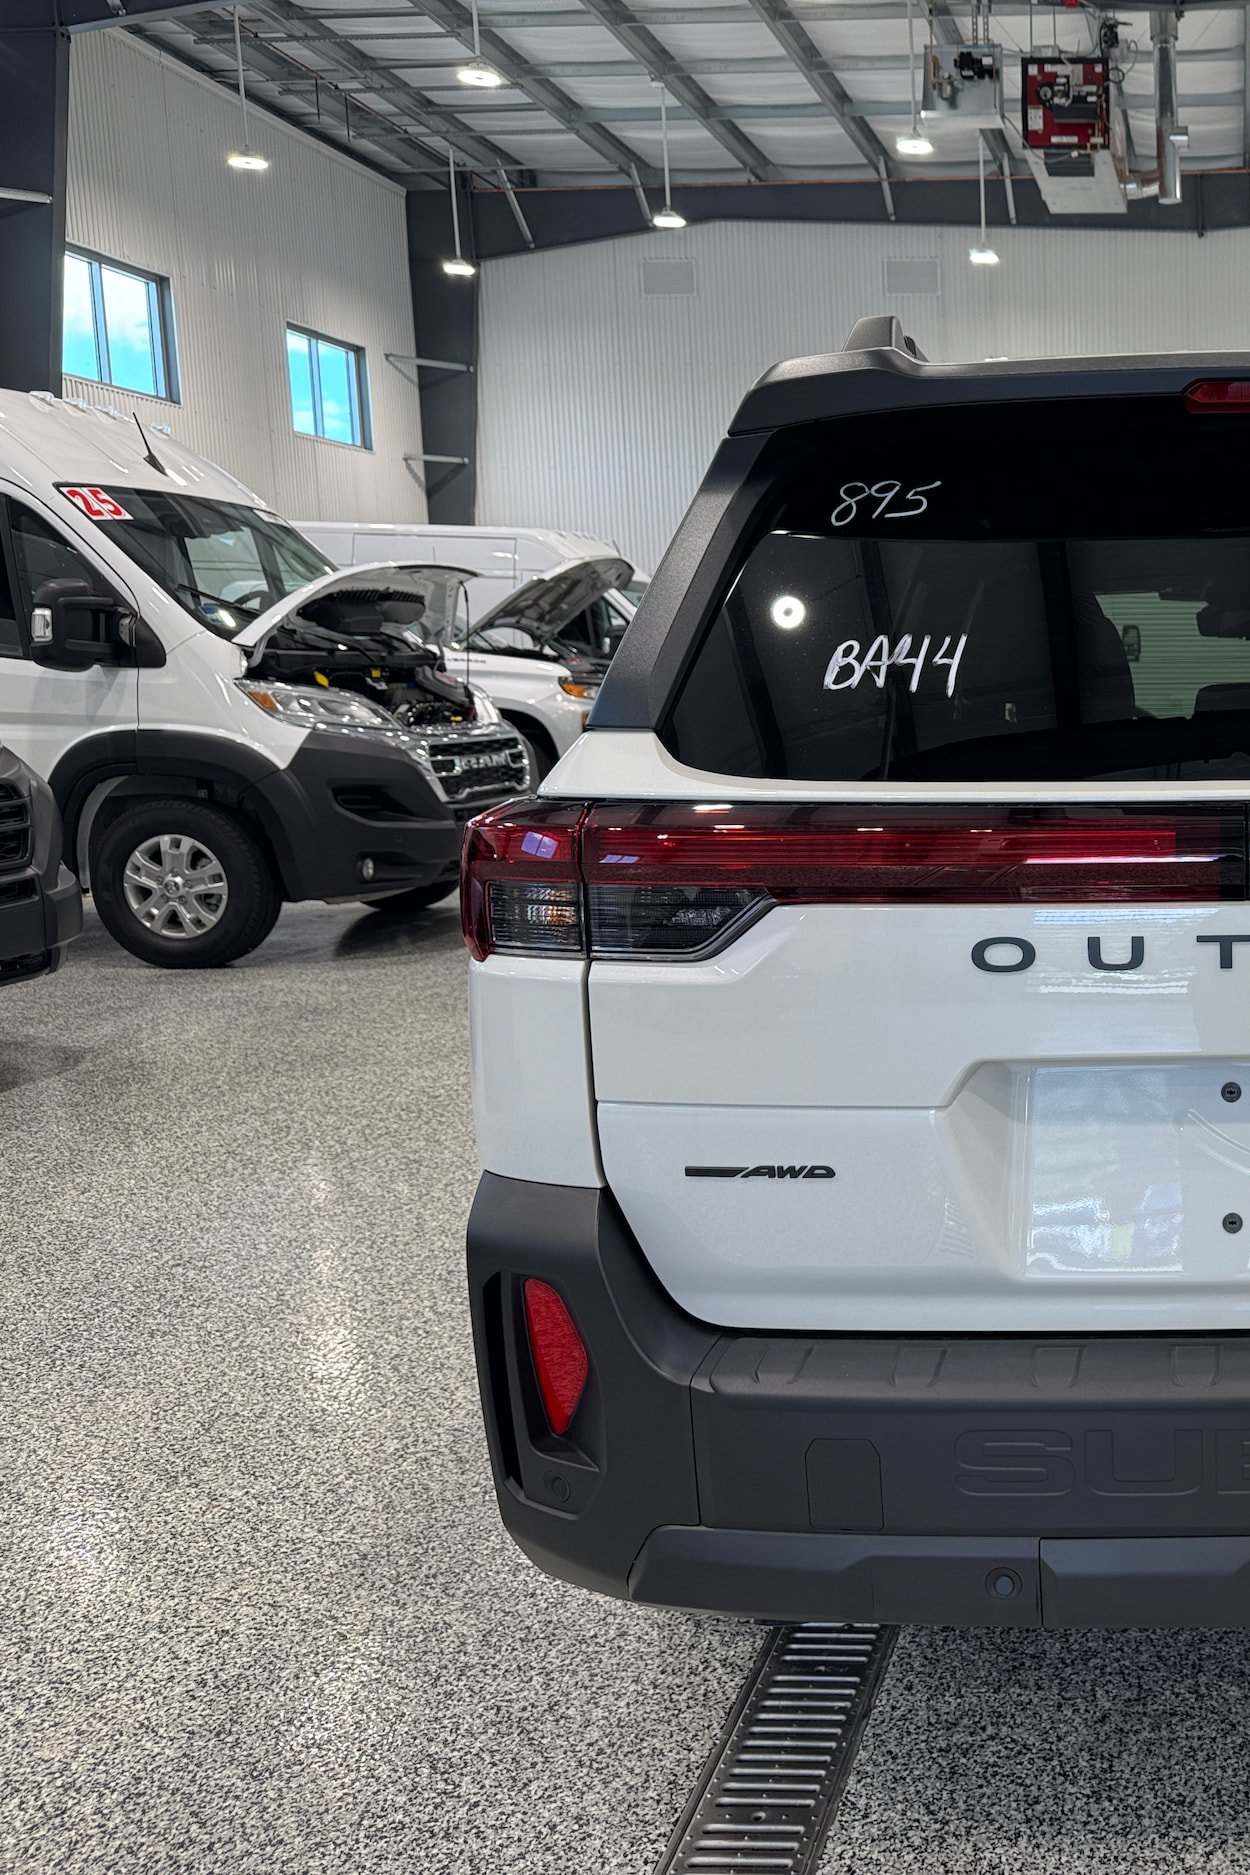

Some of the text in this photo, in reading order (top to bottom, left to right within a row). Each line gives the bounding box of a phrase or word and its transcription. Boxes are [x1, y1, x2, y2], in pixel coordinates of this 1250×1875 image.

[66, 488, 124, 517] 25
[831, 479, 942, 526] 895
[740, 1165, 836, 1179] AWD
